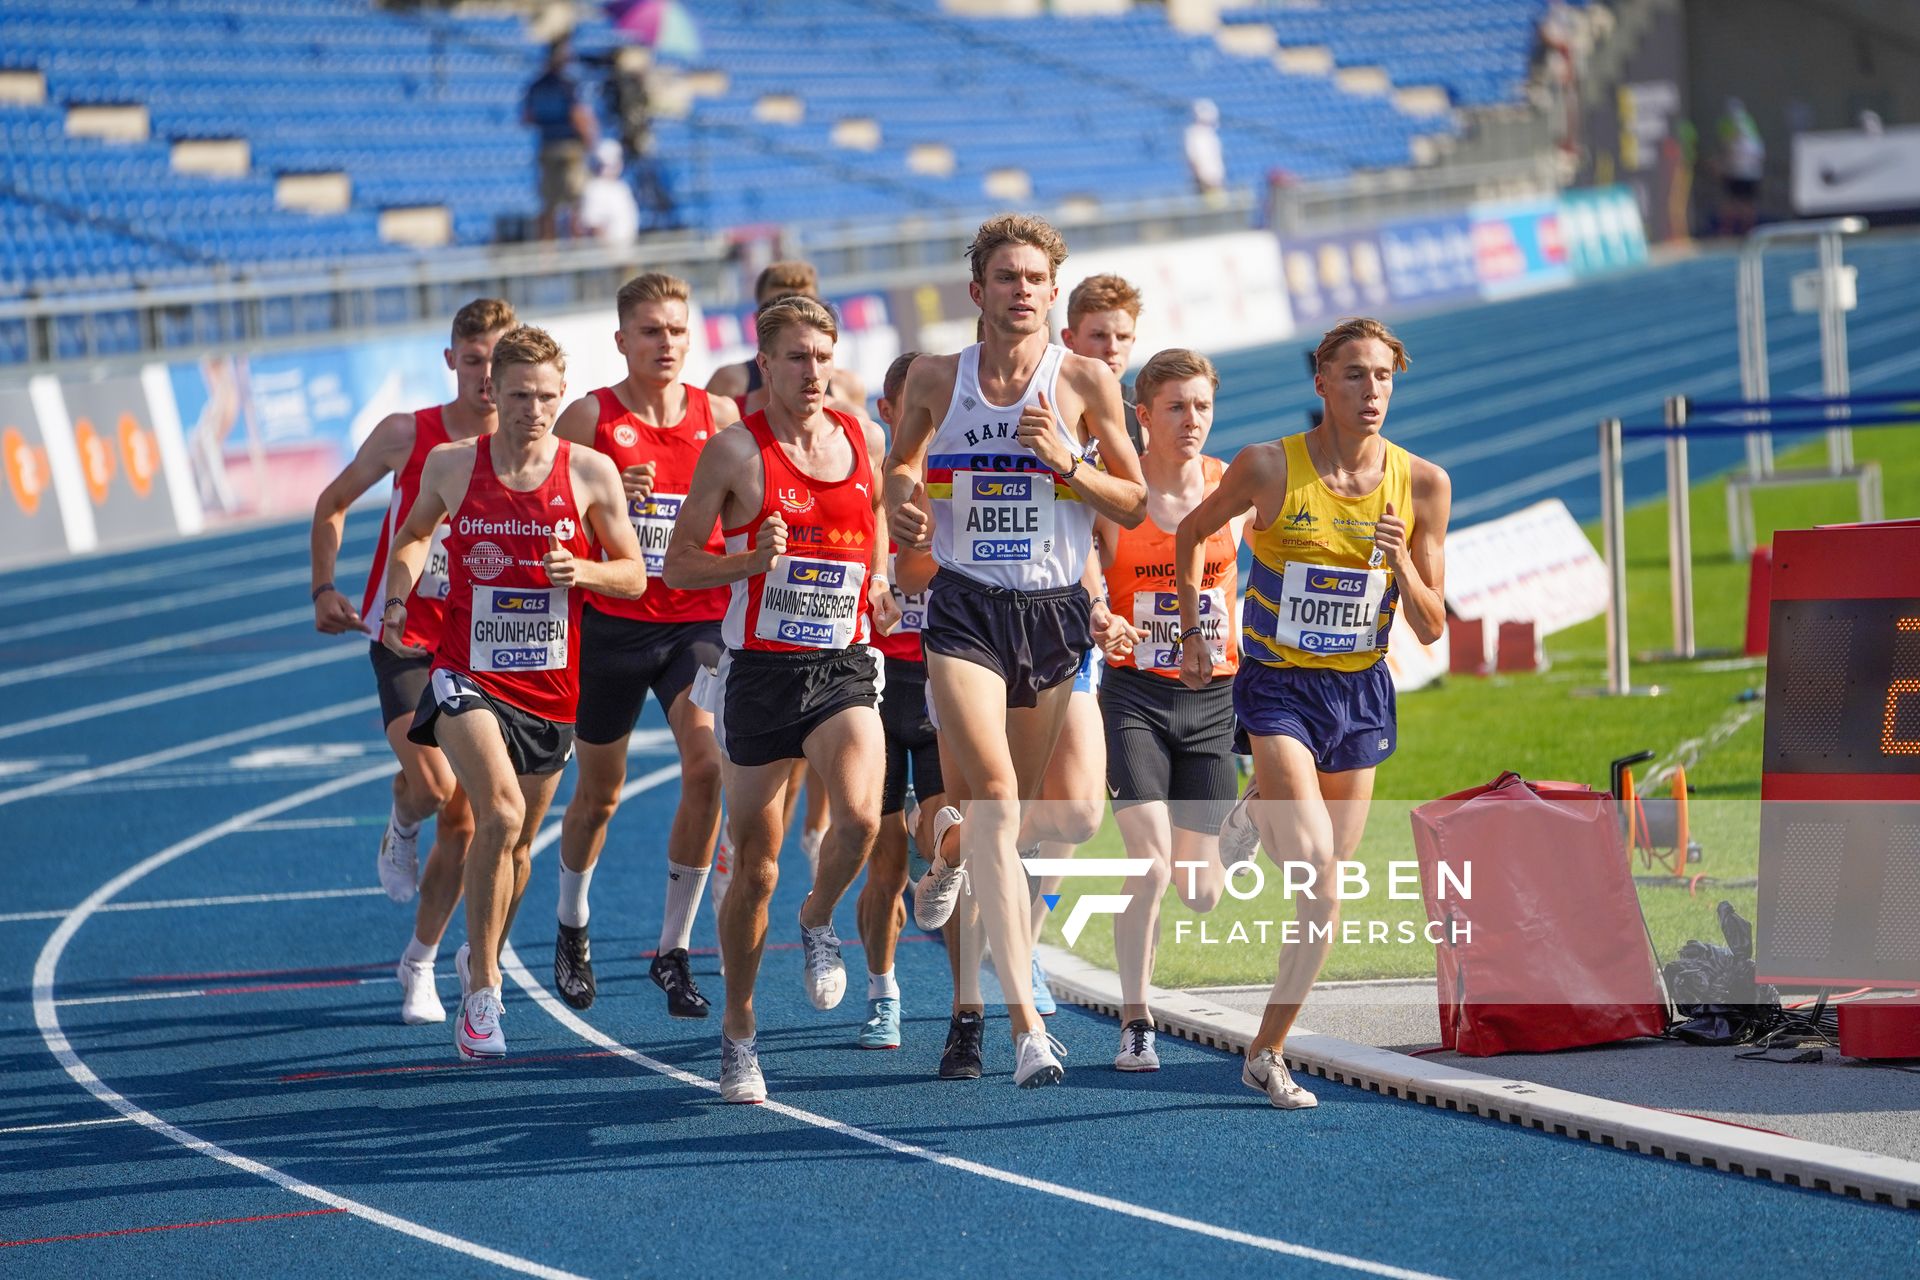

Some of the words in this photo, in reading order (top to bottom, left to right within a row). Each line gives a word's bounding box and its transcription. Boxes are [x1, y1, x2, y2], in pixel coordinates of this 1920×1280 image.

[964, 423, 1020, 447] HANA
[778, 488, 796, 500] LG
[1002, 483, 1026, 496] GLS
[656, 502, 678, 517] GLS
[459, 516, 552, 536] Öffentliche
[966, 507, 1038, 532] ABELE
[789, 525, 824, 543] WE
[996, 543, 1029, 553] PLAN
[1043, 540, 1051, 552] 169
[462, 557, 513, 565] MIETENS
[646, 557, 664, 567] PLA
[818, 571, 841, 584] GLS
[1338, 579, 1362, 593] GLS
[522, 599, 546, 610] GLS
[765, 586, 856, 619] WAMMETSBERGER
[1289, 597, 1372, 627] TORTELL
[474, 615, 565, 642] GRÜNHAGEN
[802, 625, 832, 637] PLAN
[1142, 619, 1221, 643] PINGNK
[1323, 637, 1355, 647] PLAN
[515, 651, 545, 661] PLAN
